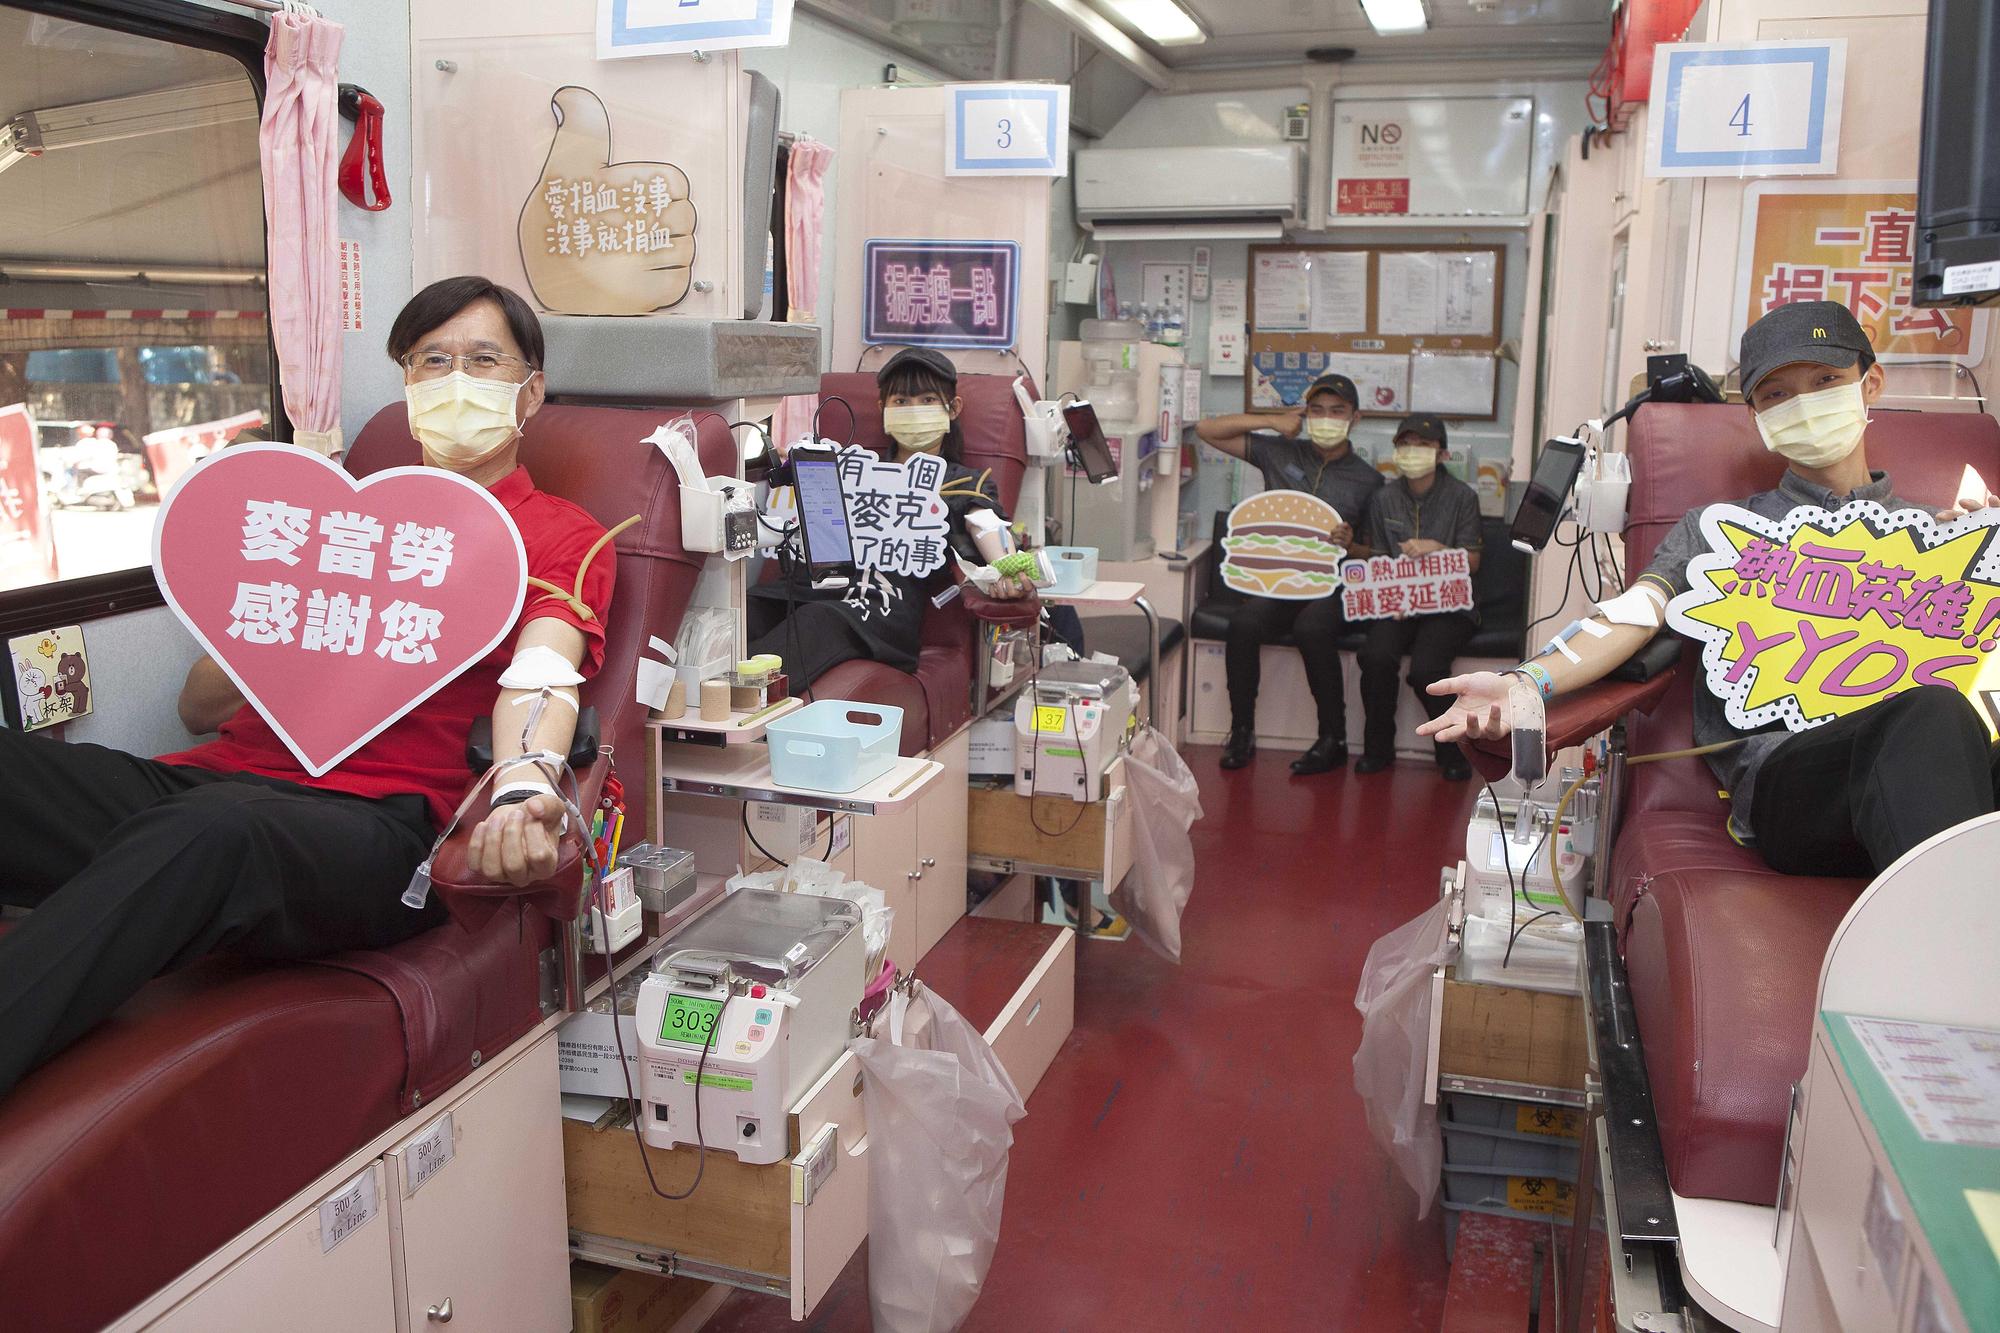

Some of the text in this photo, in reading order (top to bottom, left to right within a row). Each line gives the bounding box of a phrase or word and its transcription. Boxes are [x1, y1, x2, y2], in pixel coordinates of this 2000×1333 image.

[997, 119, 1011, 148] 3
[1729, 93, 1754, 136] 4
[545, 176, 672, 218] 愛捐血沒事
[547, 217, 674, 257] 沒事就捐血
[1820, 212, 1916, 263] 一直
[839, 450, 941, 491] 有一個
[844, 488, 943, 532] 麥克
[240, 500, 455, 587] 麥當勞
[851, 535, 942, 573] 了的事
[1371, 552, 1467, 581] 熱血相挺
[1344, 579, 1470, 618] 讓愛延續
[225, 580, 445, 664] 感謝您
[43, 697, 73, 719] 杯架
[1044, 713, 1063, 726] 37
[672, 1008, 715, 1033] 303
[417, 1153, 446, 1183] In Line
[418, 1141, 432, 1160] 500
[332, 1208, 368, 1241] In Line
[335, 1197, 350, 1217] 500
